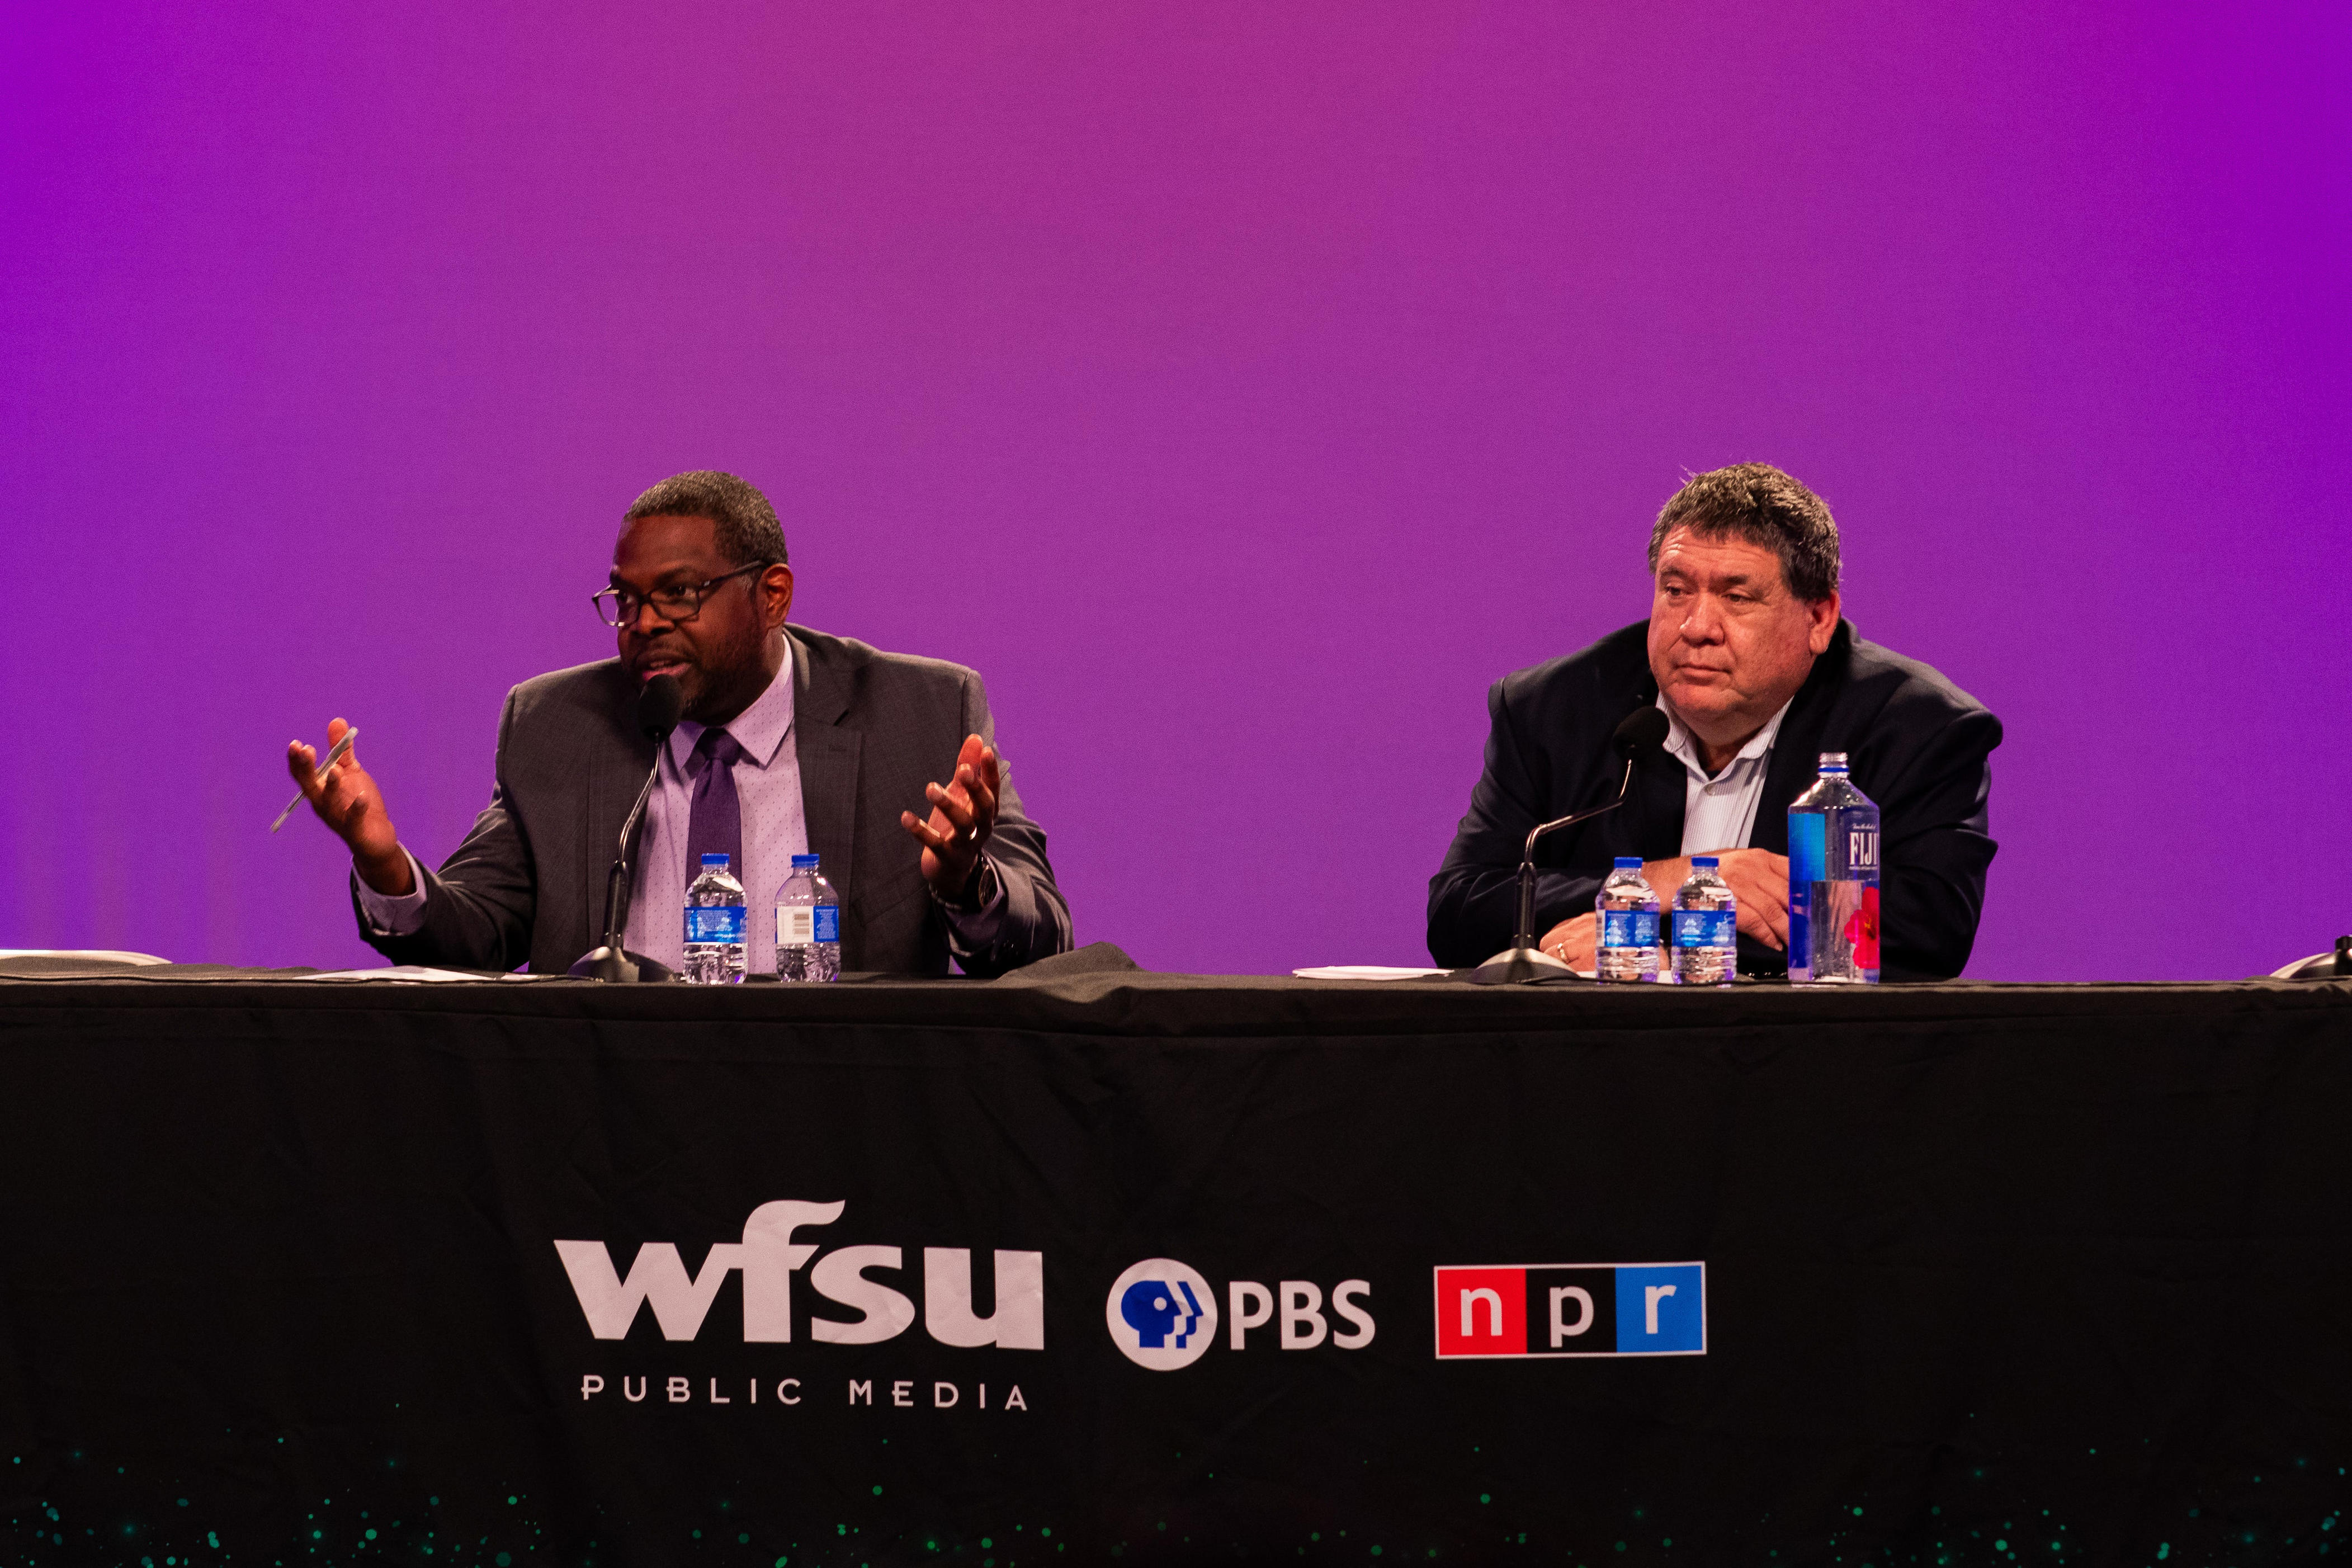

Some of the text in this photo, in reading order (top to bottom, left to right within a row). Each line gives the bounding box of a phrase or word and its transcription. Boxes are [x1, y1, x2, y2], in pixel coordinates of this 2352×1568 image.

[1849, 832, 1877, 865] FIJI
[553, 1199, 1045, 1350] wfsu
[1229, 1279, 1376, 1350] PBS
[1460, 1284, 1677, 1348] npr
[580, 1375, 1027, 1411] PUBLIC MEDIA
